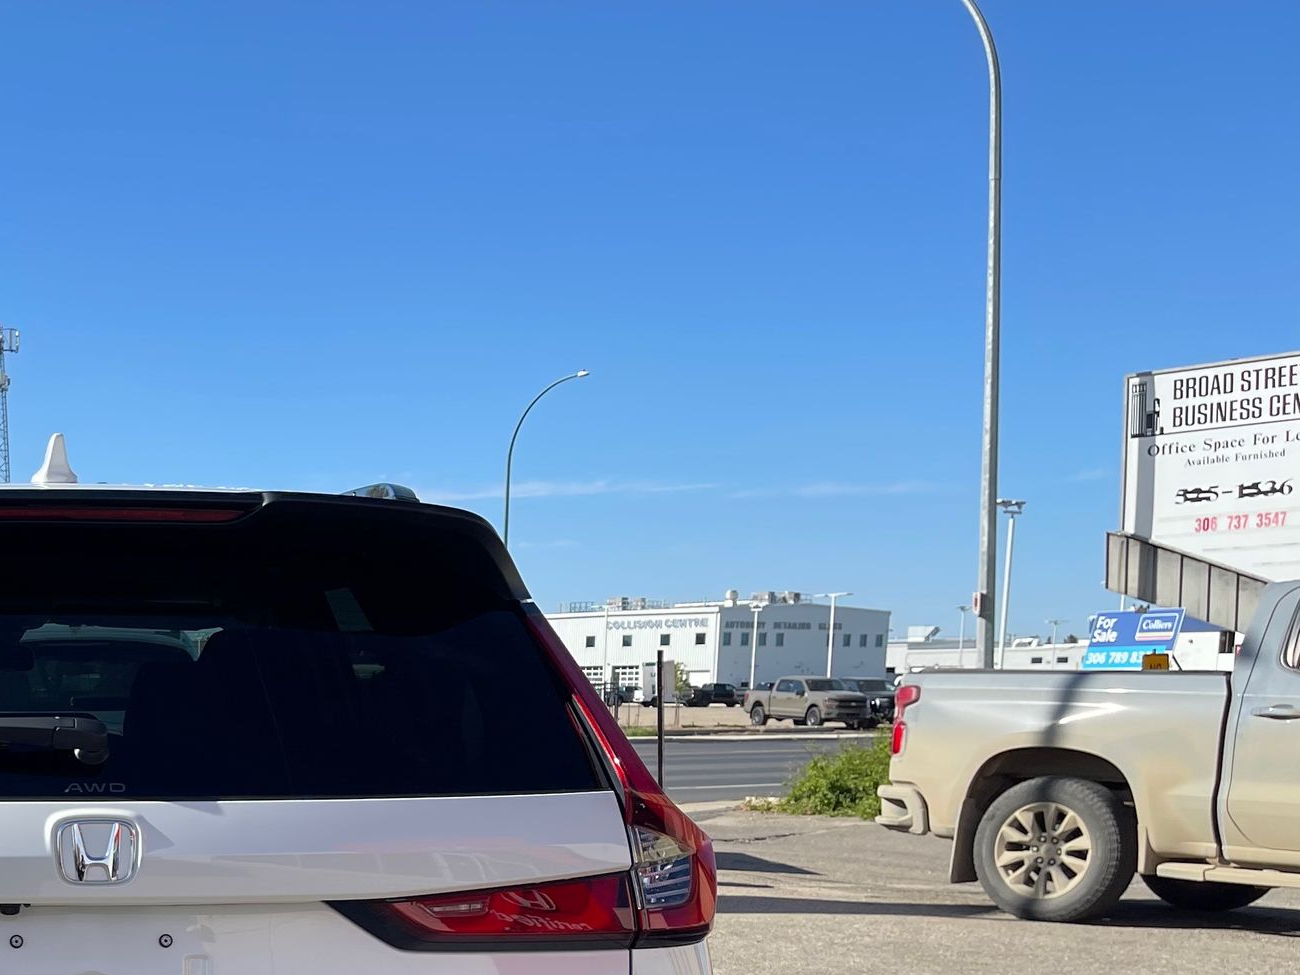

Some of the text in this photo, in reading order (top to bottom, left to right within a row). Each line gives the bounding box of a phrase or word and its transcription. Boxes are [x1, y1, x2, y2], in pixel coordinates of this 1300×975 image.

[1173, 364, 1300, 400] BROAD STREE
[1173, 397, 1262, 427] BUSINESS
[1147, 442, 1196, 457] Office
[1203, 438, 1245, 452] Space
[1253, 432, 1277, 446] For
[1185, 449, 1286, 468] Available Furnished
[1195, 511, 1287, 532] 306 737 3547
[607, 617, 709, 630] COLLISION CENTRE
[1097, 615, 1118, 629] For
[1092, 629, 1118, 643] Sale
[1085, 652, 1106, 665] 306
[1108, 651, 1129, 664] 789
[64, 782, 126, 793] AWD
